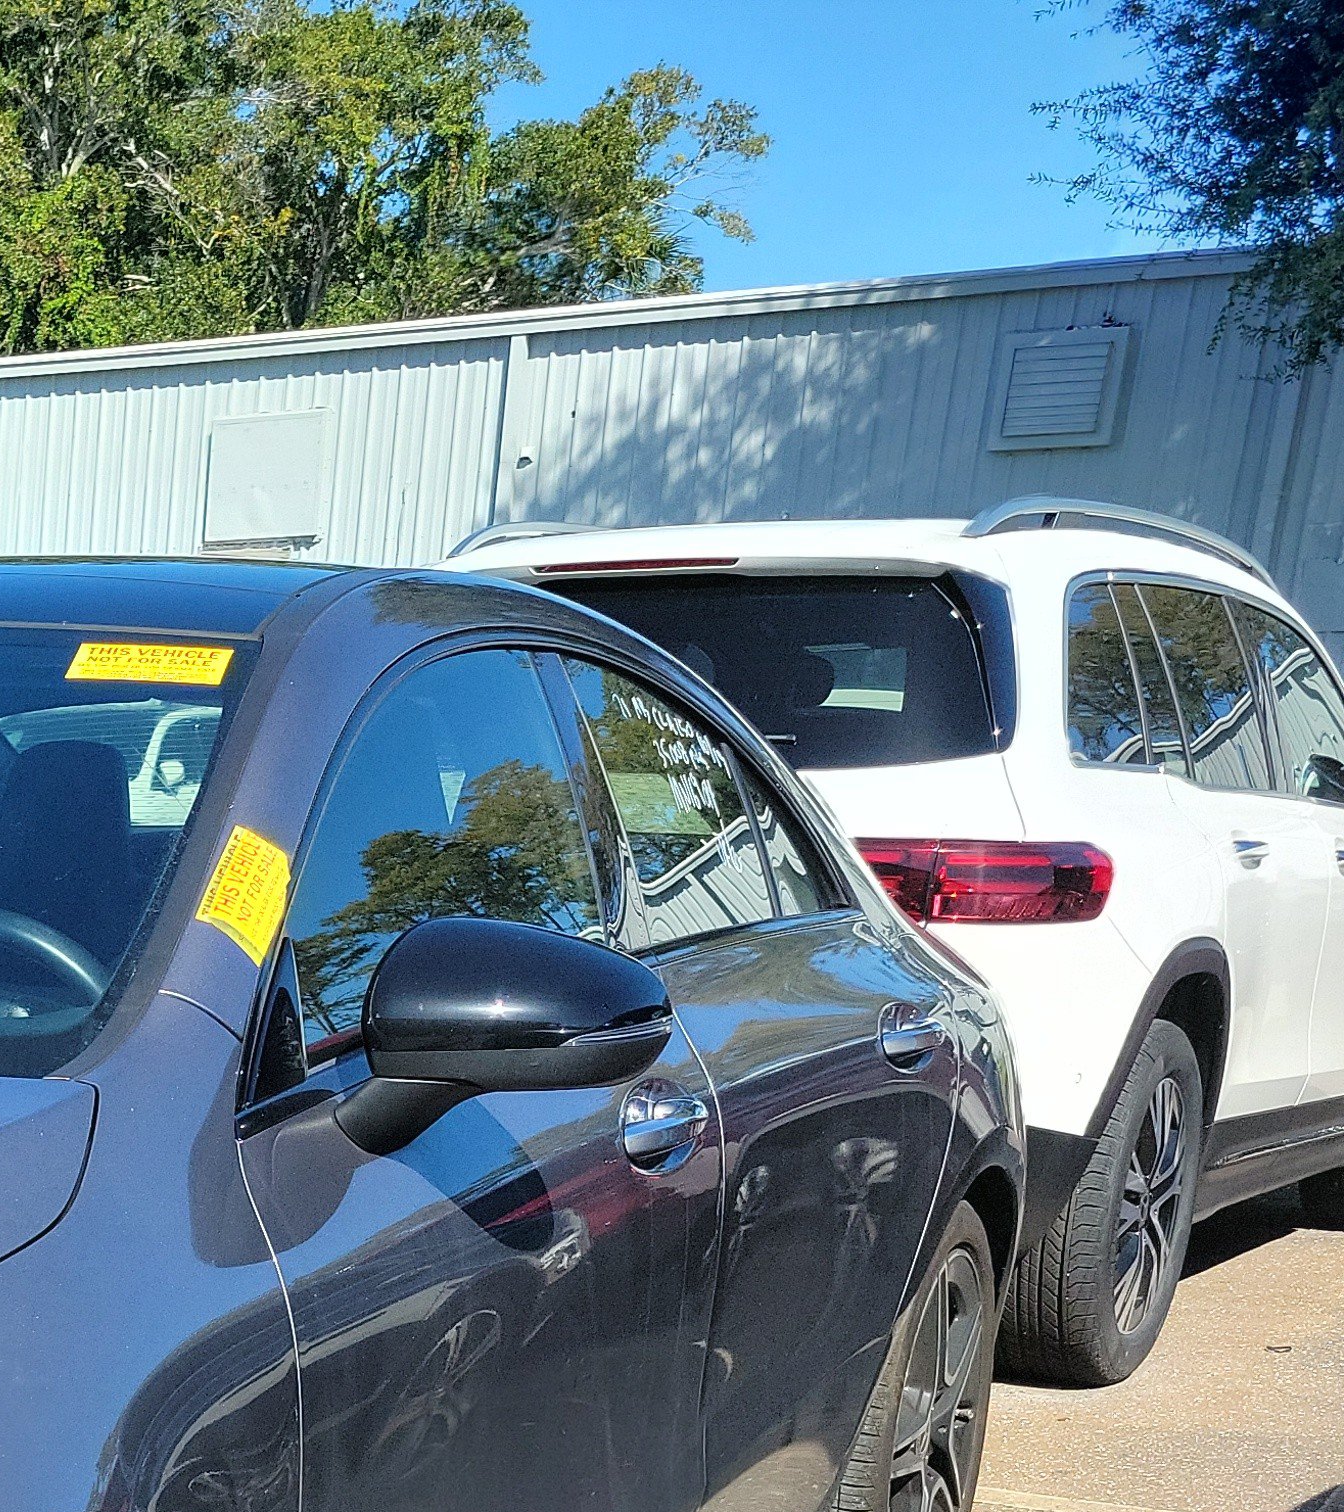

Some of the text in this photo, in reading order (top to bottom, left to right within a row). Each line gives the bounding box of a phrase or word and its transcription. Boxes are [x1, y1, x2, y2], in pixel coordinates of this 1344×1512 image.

[88, 647, 221, 660] THIS VEHICLE
[127, 657, 160, 665] FOR
[168, 658, 212, 667] SALE
[214, 829, 264, 916] THIS VEHICLE
[237, 898, 253, 924] NOT
[247, 876, 265, 900] FOR
[258, 845, 279, 876] SALE
